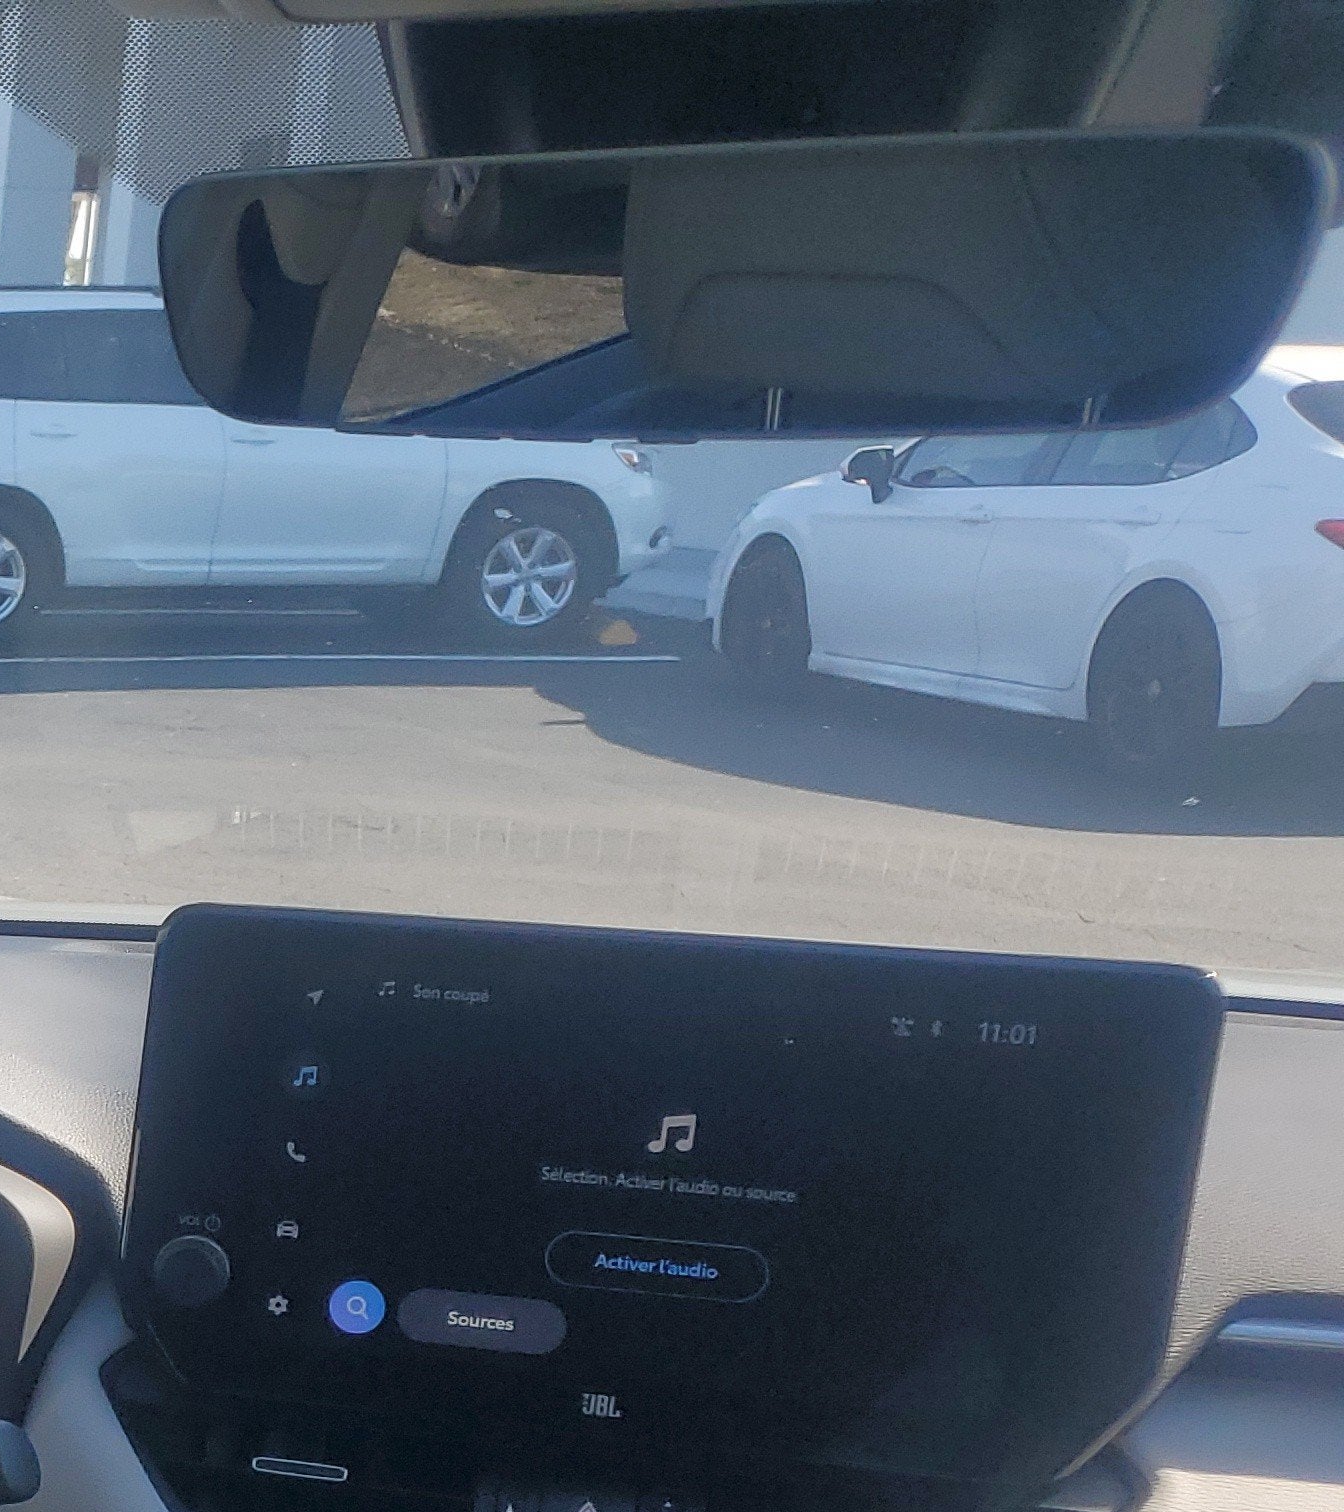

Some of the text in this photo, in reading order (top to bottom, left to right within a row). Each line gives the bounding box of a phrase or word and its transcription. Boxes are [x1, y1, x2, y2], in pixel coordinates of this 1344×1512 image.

[978, 1022, 1038, 1045] 11:01
[594, 1254, 719, 1280] Activer l'audio
[447, 1311, 515, 1331] Sources
[581, 1392, 621, 1418] JBL
